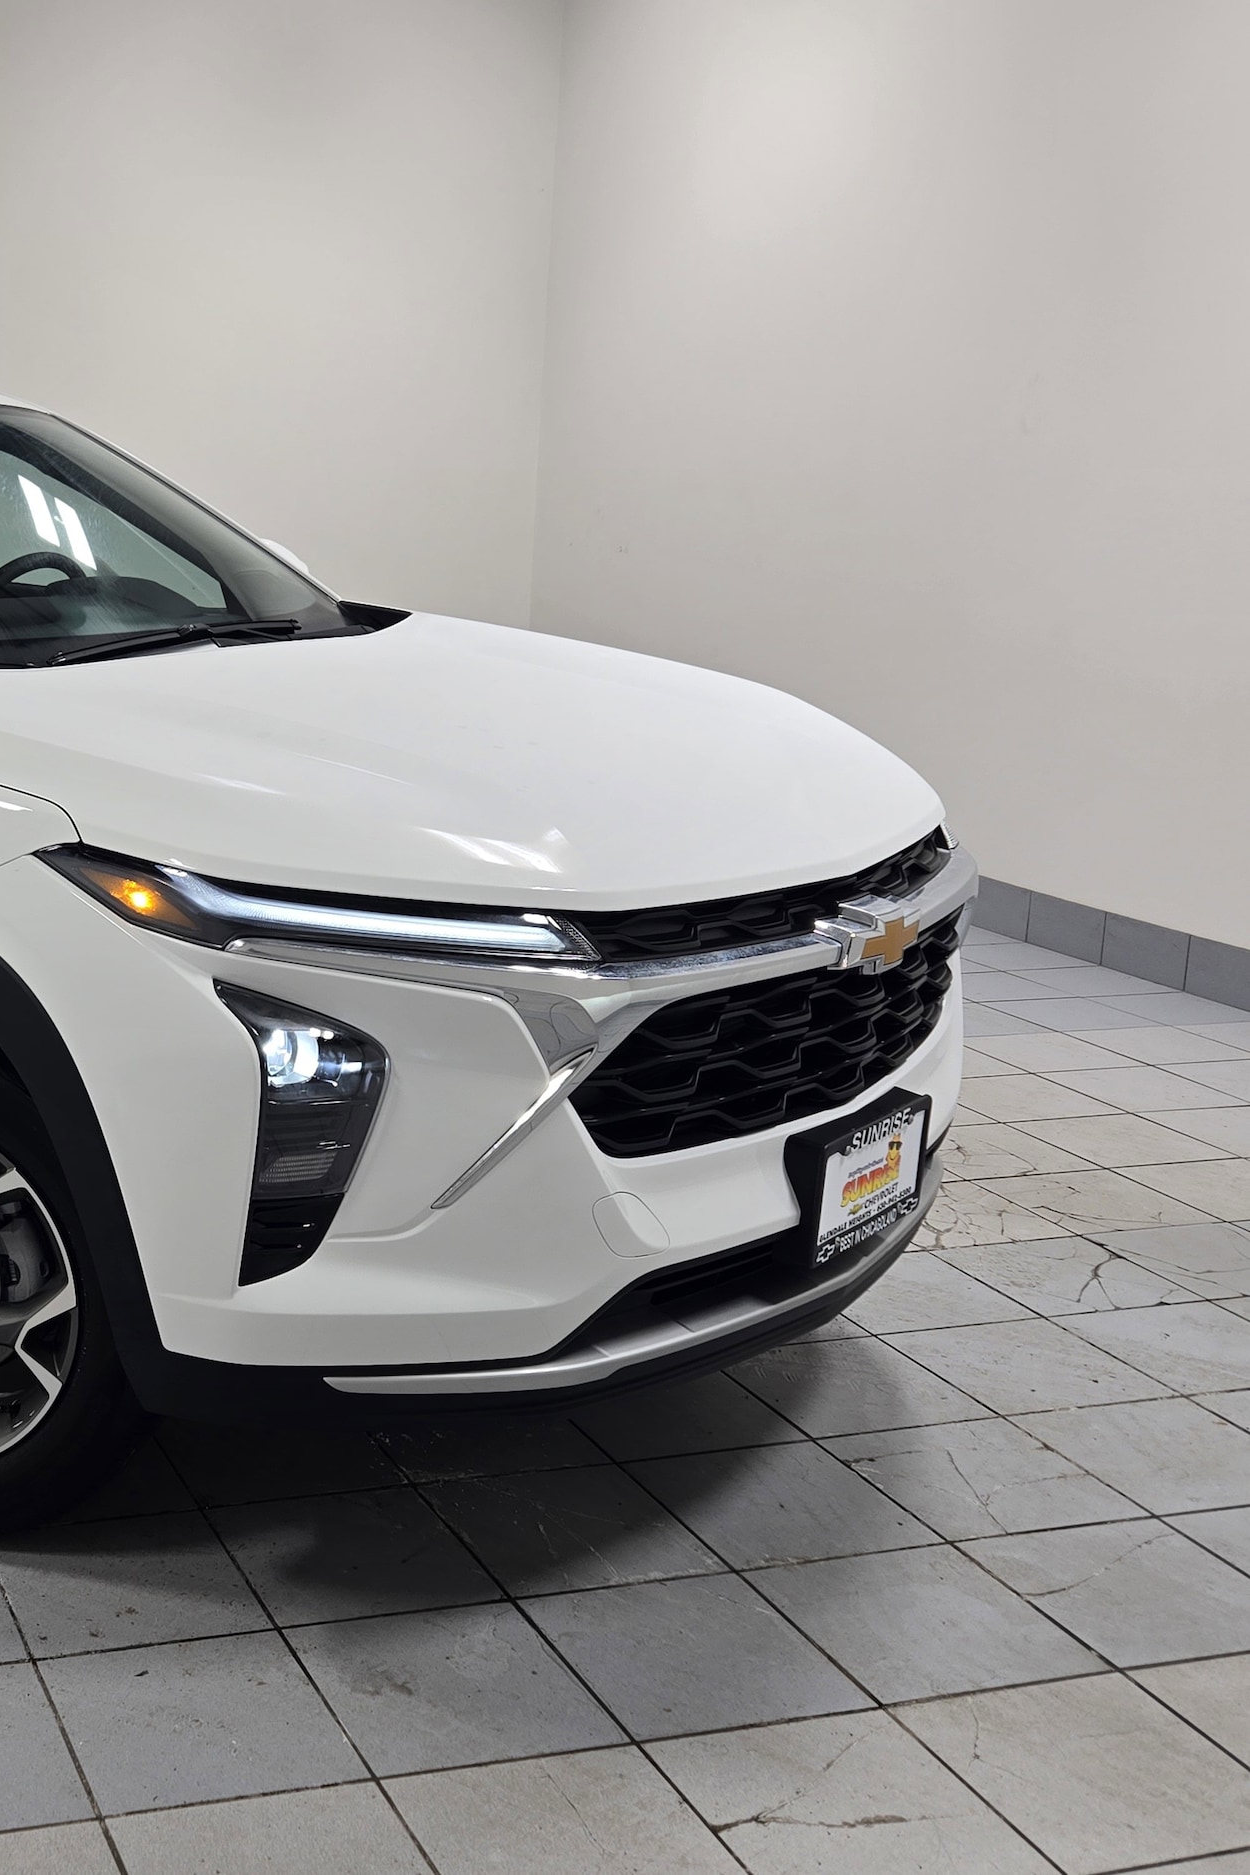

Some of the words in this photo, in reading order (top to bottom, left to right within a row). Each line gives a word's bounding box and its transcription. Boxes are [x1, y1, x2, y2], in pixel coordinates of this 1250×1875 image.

[851, 1107, 912, 1151] SUNRISE
[840, 1163, 899, 1208] SUNRISE
[863, 1182, 898, 1209] CHEVROLET
[819, 1222, 847, 1243] GLENDALE
[849, 1209, 872, 1228] HEIGHTS
[840, 1231, 856, 1253] BEST
[861, 1207, 898, 1241] CHICAGOLAND
